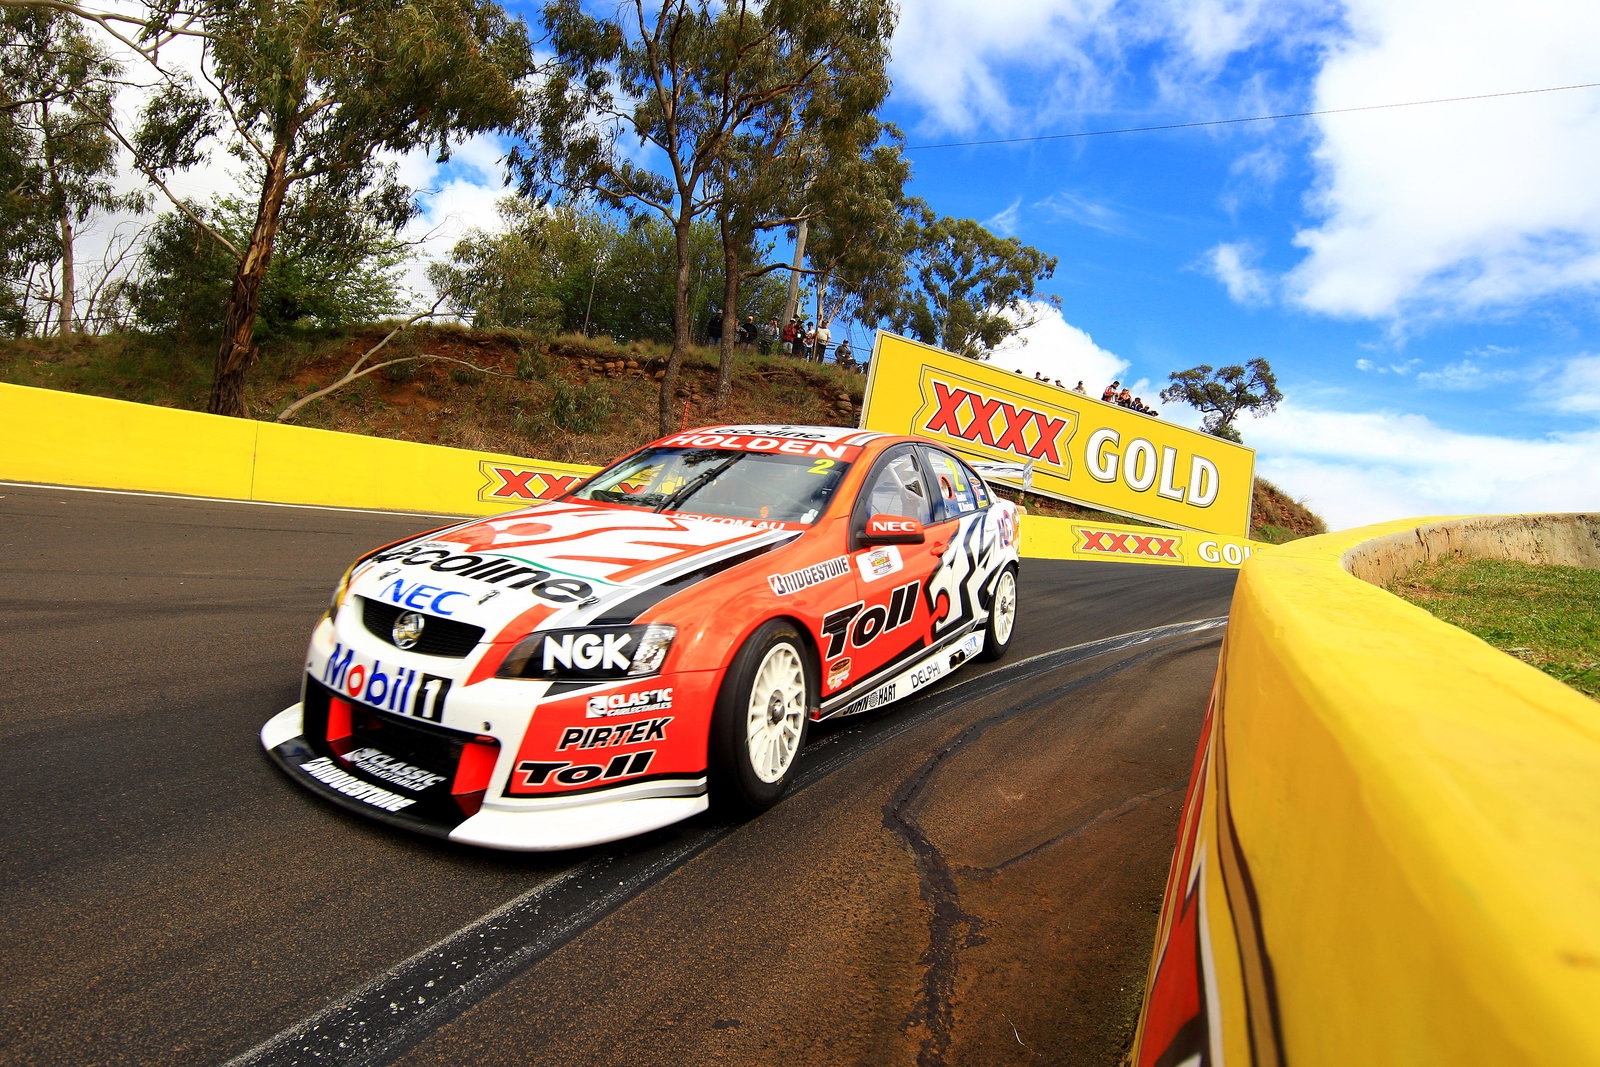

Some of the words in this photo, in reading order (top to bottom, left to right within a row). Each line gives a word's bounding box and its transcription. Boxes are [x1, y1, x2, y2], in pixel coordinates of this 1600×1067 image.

[662, 434, 848, 458] HOLDEN
[714, 428, 827, 440] ecoline
[925, 380, 1068, 466] XXXX
[1084, 427, 1220, 509] GOLD
[807, 458, 835, 475] 2
[944, 457, 966, 492] 2
[872, 521, 916, 532] NEC
[1080, 529, 1178, 558] XXXX
[772, 556, 849, 595] BRIDGESTONE
[379, 578, 470, 616] NEC
[821, 580, 921, 660] Toll
[542, 633, 633, 671] NGK
[323, 643, 416, 713] Mobil
[422, 678, 443, 719] 1
[910, 661, 941, 689] DELPHI
[878, 683, 897, 705] HART
[555, 716, 675, 752] PIRTEK
[368, 754, 448, 787] CLASSIC
[516, 750, 657, 786] Toll
